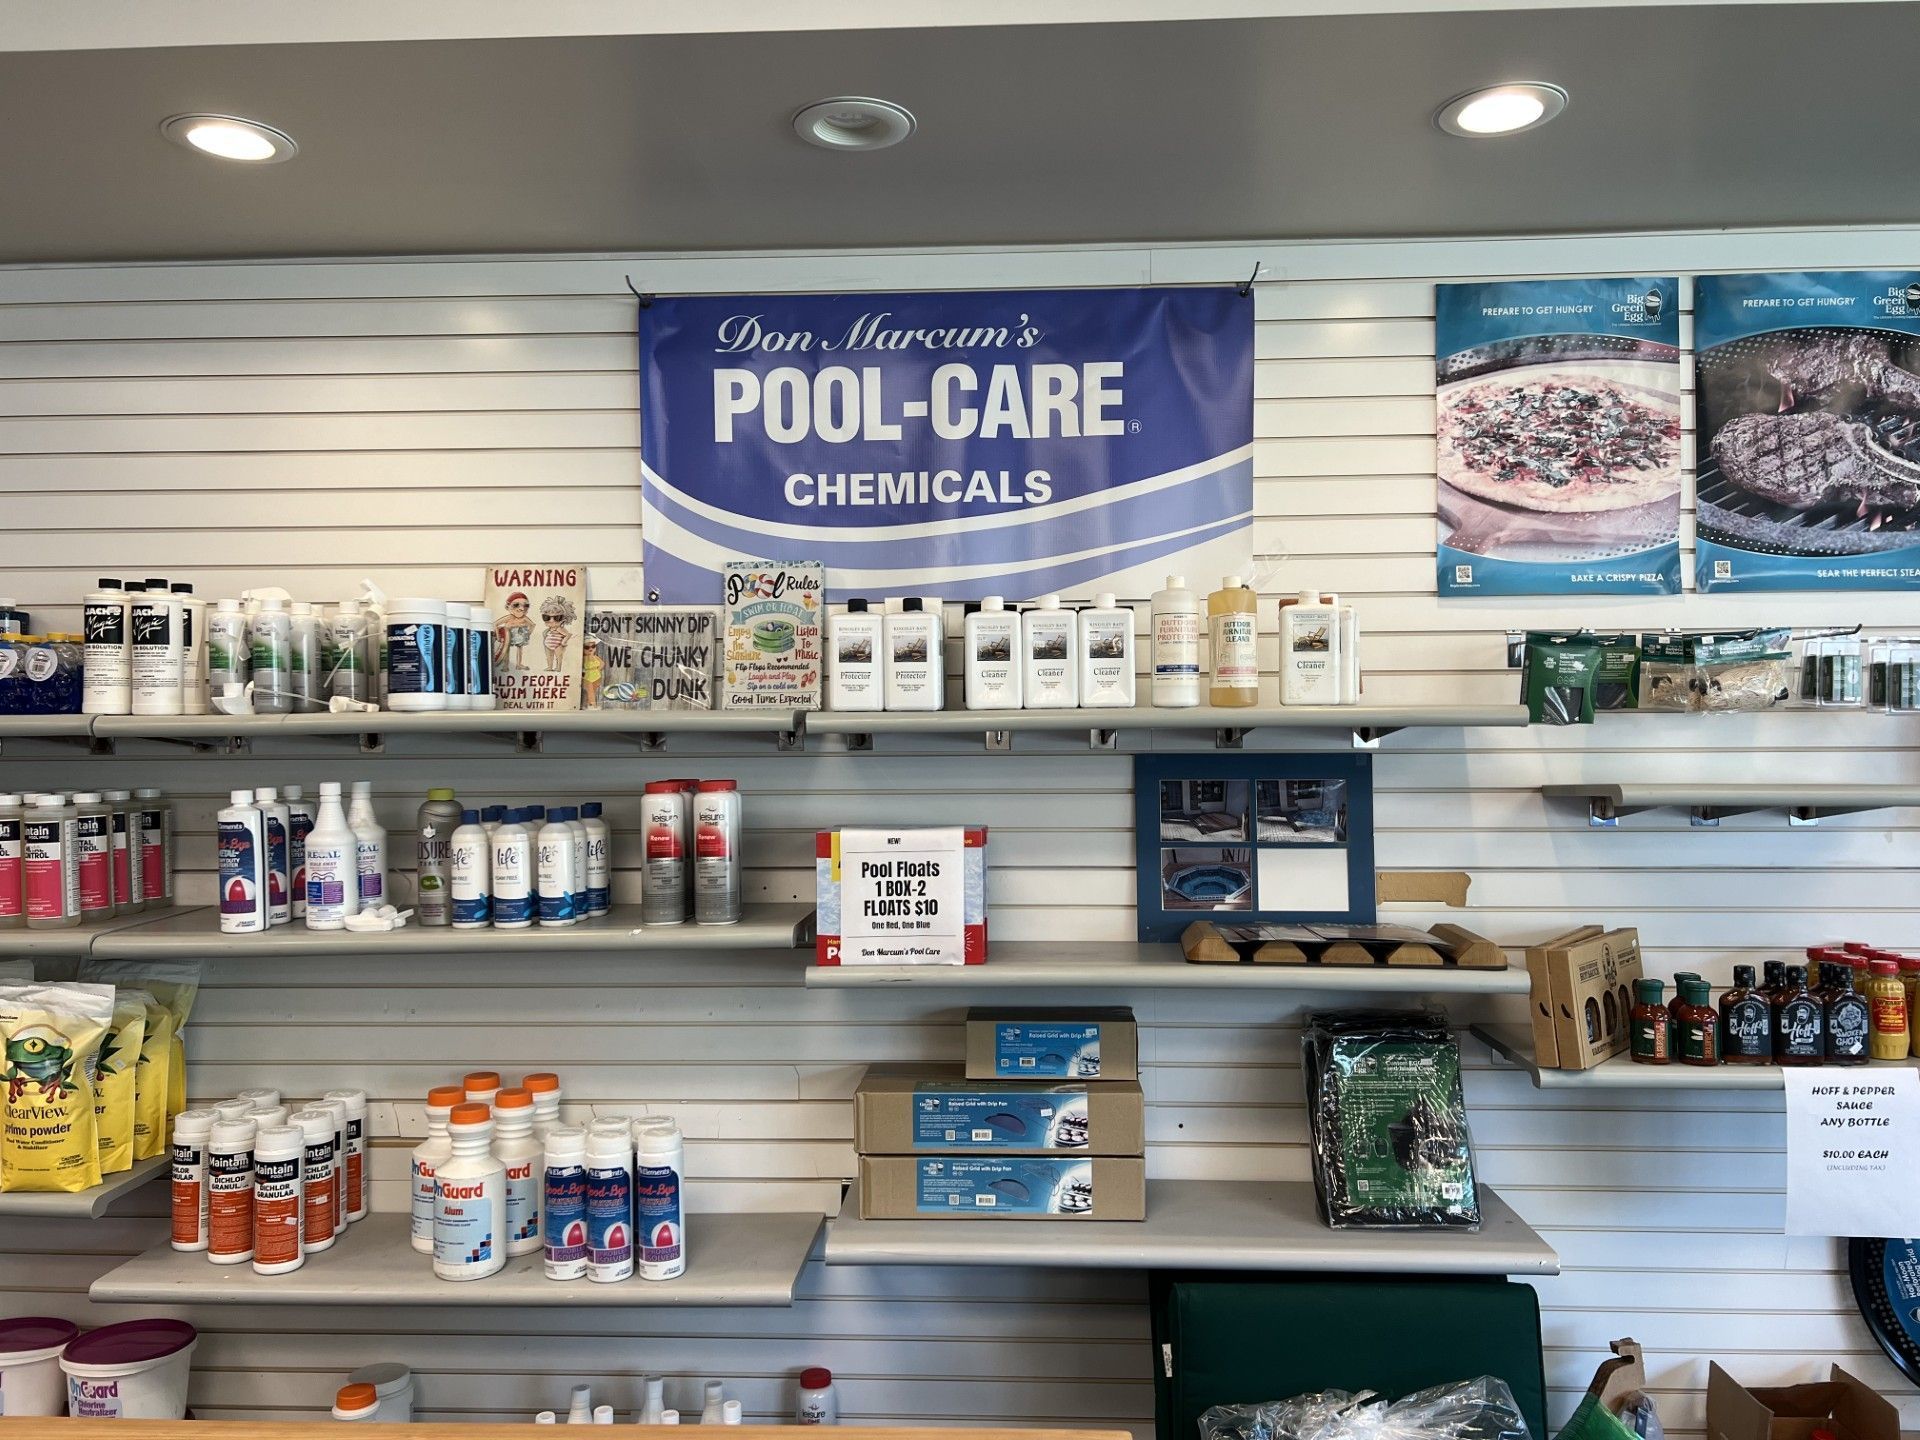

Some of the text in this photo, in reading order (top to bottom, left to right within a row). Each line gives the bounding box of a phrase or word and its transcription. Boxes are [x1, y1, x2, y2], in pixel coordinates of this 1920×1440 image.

[1887, 287, 1906, 298] Big
[1626, 294, 1644, 305] Big
[1743, 297, 1856, 308] PREPARE TO GET HUNGRY
[1873, 296, 1906, 306] Green
[1482, 304, 1594, 316] PREPARE TO GET HUNGRY
[1611, 303, 1644, 313] Green
[1885, 304, 1906, 315] Egg
[1623, 312, 1644, 323] Egg
[716, 310, 1044, 354] Don Marcum's
[713, 361, 1125, 444] POOL-CARE
[783, 469, 1053, 507] CHEMICALS
[494, 569, 577, 587] WARNING
[1571, 572, 1664, 582] BAKE A CRISPY PIZZA
[1817, 568, 1920, 577] SEAR THE PERFECT STEA
[786, 575, 820, 591] Rules
[742, 603, 764, 617] SWIM
[86, 615, 121, 640] Magic
[133, 617, 167, 641] Magic
[590, 616, 710, 634] DON'T SKINNY DIP
[796, 625, 818, 637] Listen
[607, 646, 709, 669] WE CHUNKY
[795, 648, 818, 660] Music
[735, 663, 810, 672] Flip Flops Recommended
[1296, 660, 1325, 669] Cleaner
[769, 671, 780, 680] and
[781, 671, 797, 682] Play
[840, 671, 871, 680] Protector
[895, 671, 926, 680] Protector
[981, 669, 1007, 678] Cleaner
[1037, 668, 1063, 677] Cleaner
[1093, 667, 1120, 676] Cleaner
[521, 675, 570, 687] PEOPLE
[747, 682, 758, 691] Sip
[773, 682, 786, 690] cold
[532, 688, 567, 700] HERE
[652, 678, 708, 701] DUNK
[732, 693, 812, 706] Good Times Expected
[887, 837, 901, 845] NEW!
[587, 839, 605, 861] life
[497, 847, 519, 870] life
[861, 860, 940, 878] Pool Floats
[875, 880, 926, 897] 1 BOX-2
[864, 899, 938, 917] FLOATS $10
[871, 920, 931, 931] One Red, One Blue
[861, 947, 941, 957] Don Marcum's Pool Care
[1836, 1036, 1864, 1046] GHOST
[1812, 1086, 1895, 1095] HOFF & PEPPER
[1836, 1101, 1873, 1110] SAUCE
[1820, 1117, 1890, 1128] ANY BOTTLE
[30, 1123, 72, 1138] powder
[1823, 1150, 1889, 1159] $10.00 EACH
[255, 1163, 294, 1177] Maintain
[260, 1183, 290, 1192] DICHLOR
[257, 1189, 294, 1199] GRANULAR
[444, 1206, 464, 1216] Alum
[1898, 1261, 1910, 1283] Moon
[78, 1400, 106, 1409] Chlorine
[79, 1407, 117, 1417] Neutralizer
